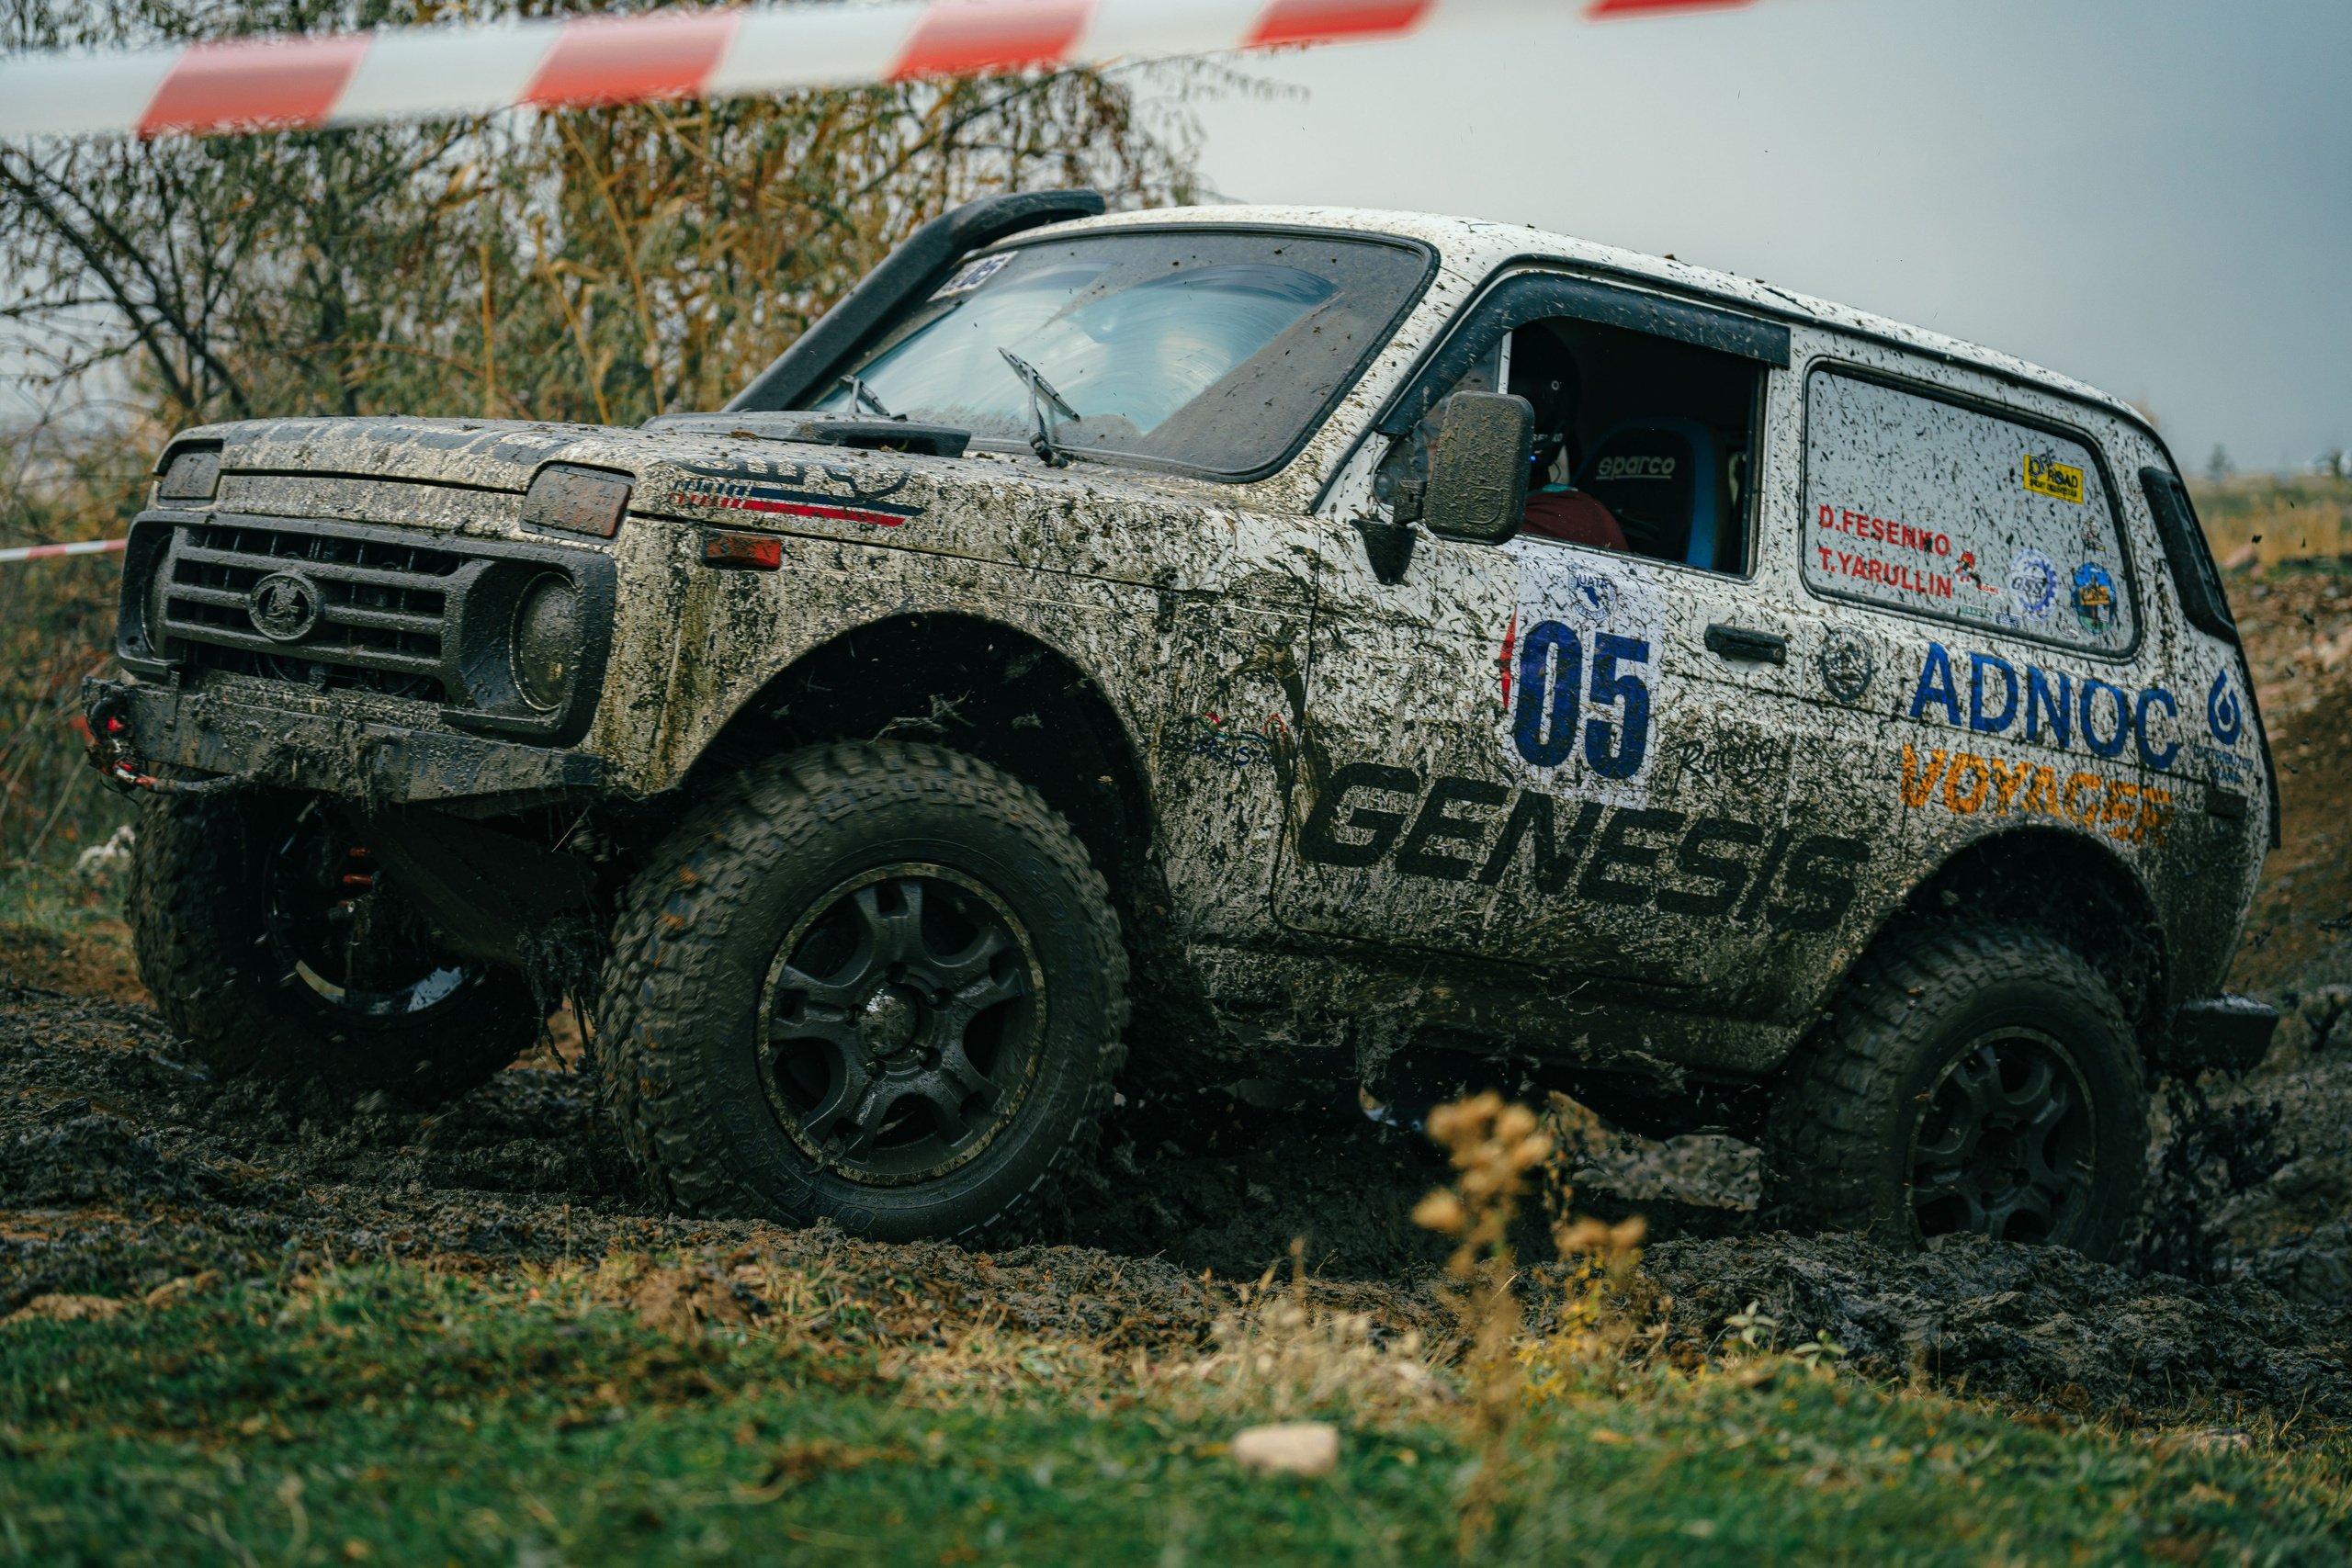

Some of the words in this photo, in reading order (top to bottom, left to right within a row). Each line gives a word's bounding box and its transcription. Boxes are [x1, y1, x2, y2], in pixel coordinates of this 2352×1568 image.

[1598, 456, 1677, 480] sparco
[2048, 469, 2078, 489] ROAD
[1818, 504, 1951, 558] D.FESENKO
[1578, 573, 1609, 591] UATA
[1817, 547, 1952, 600] T.YARULLIN
[1513, 619, 1650, 781] 05
[1908, 641, 2179, 770] ADNOC
[1900, 743, 2176, 846] VOYAGER
[1297, 761, 1871, 932] GENESIS
